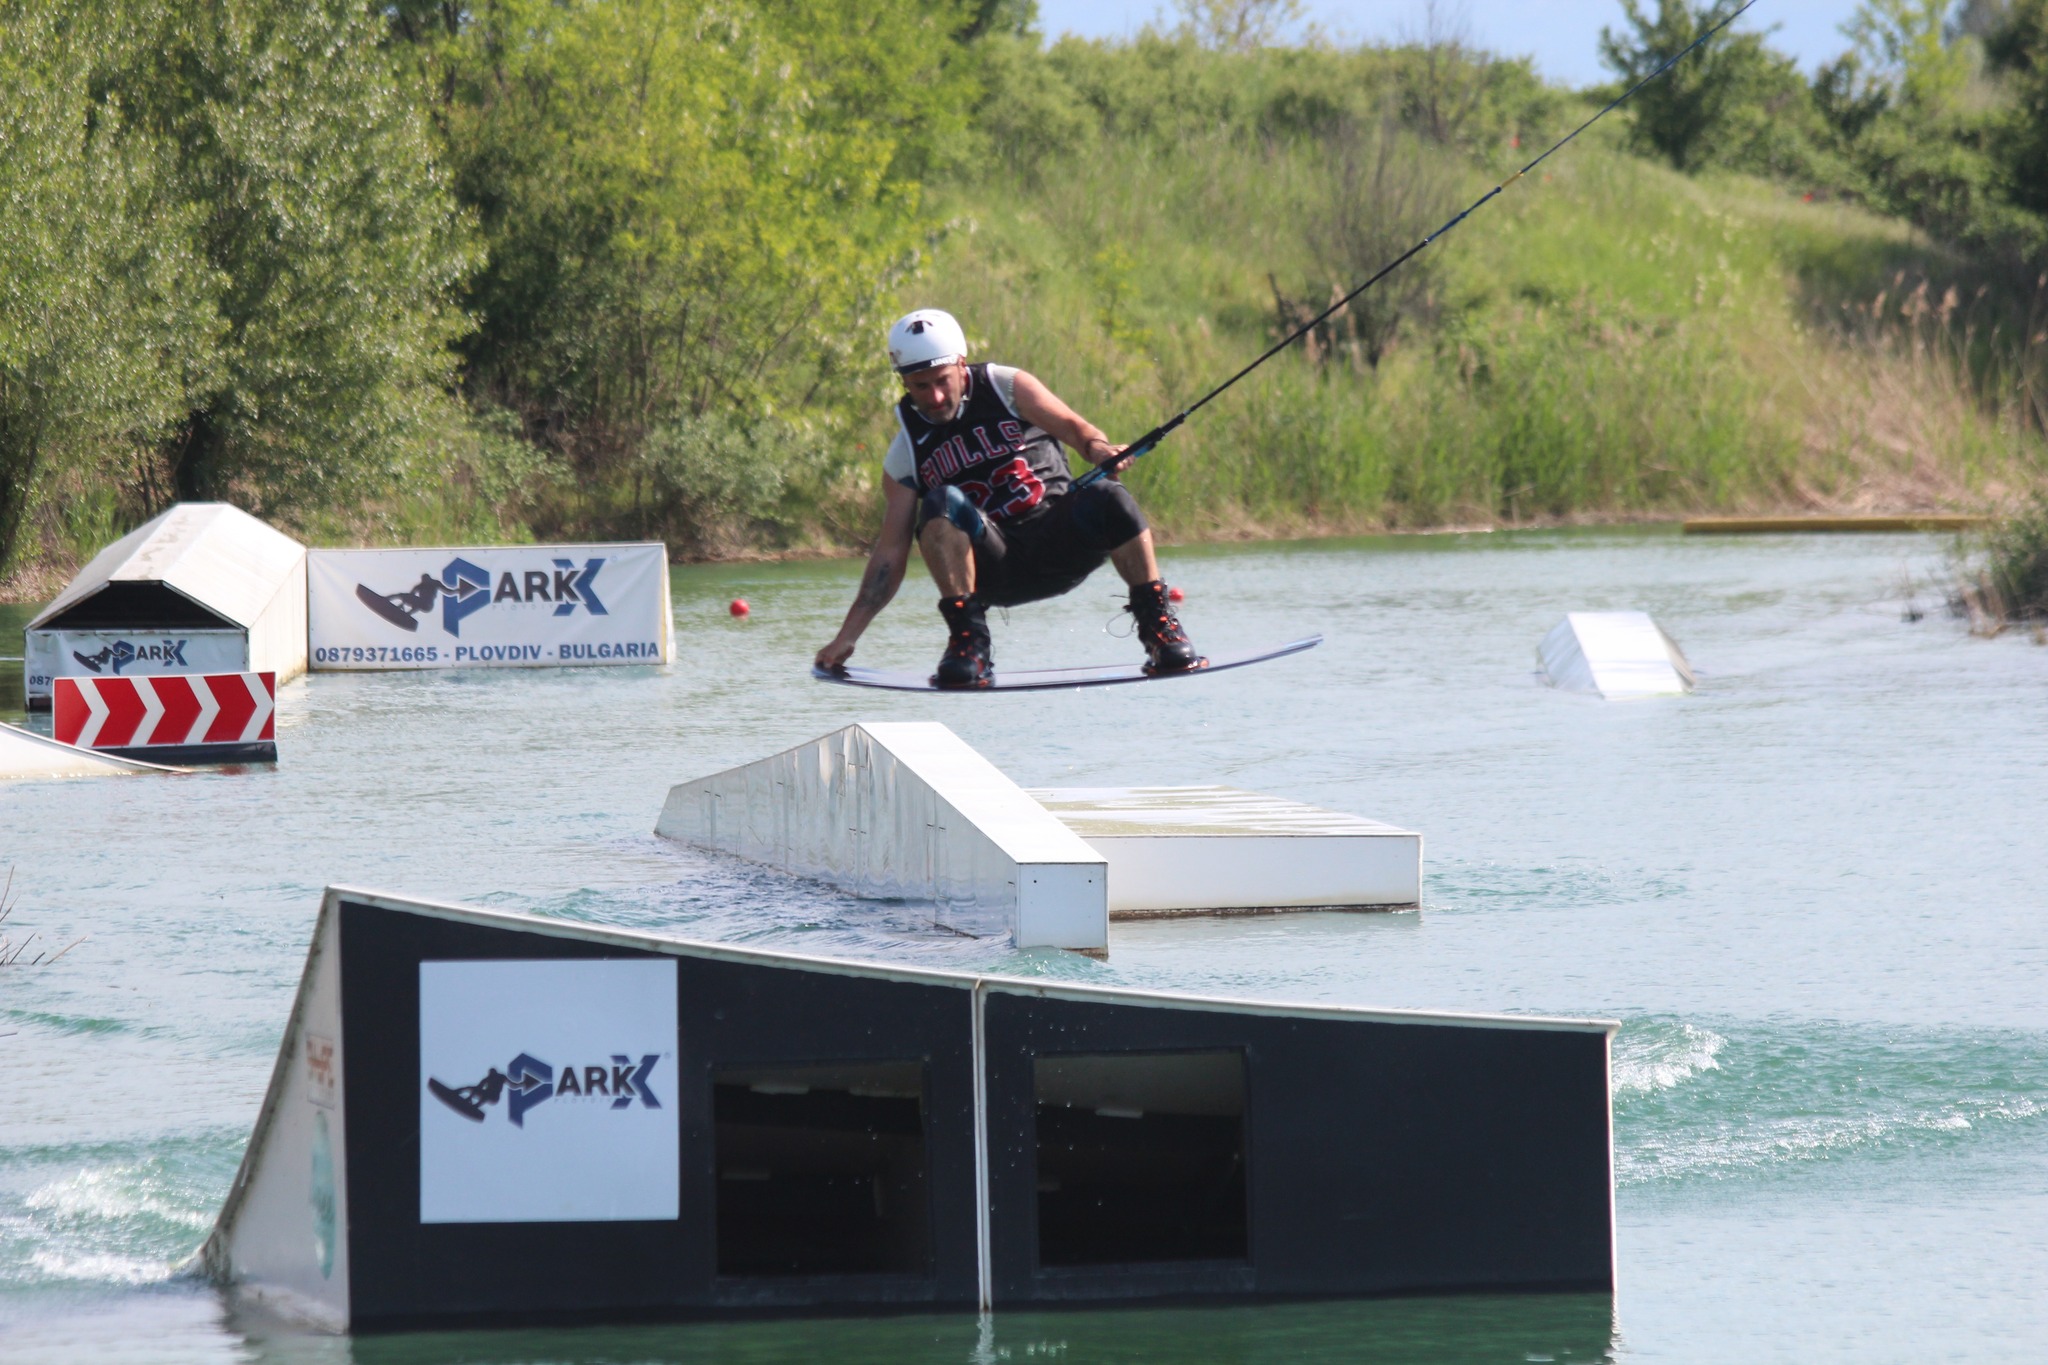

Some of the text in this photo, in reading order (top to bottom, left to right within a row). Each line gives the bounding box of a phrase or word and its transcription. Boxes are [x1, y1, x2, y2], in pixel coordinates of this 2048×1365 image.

[315, 646, 438, 663] 0879371665
[455, 644, 542, 662] PLOVDIV
[559, 642, 660, 660] BULGARIA
